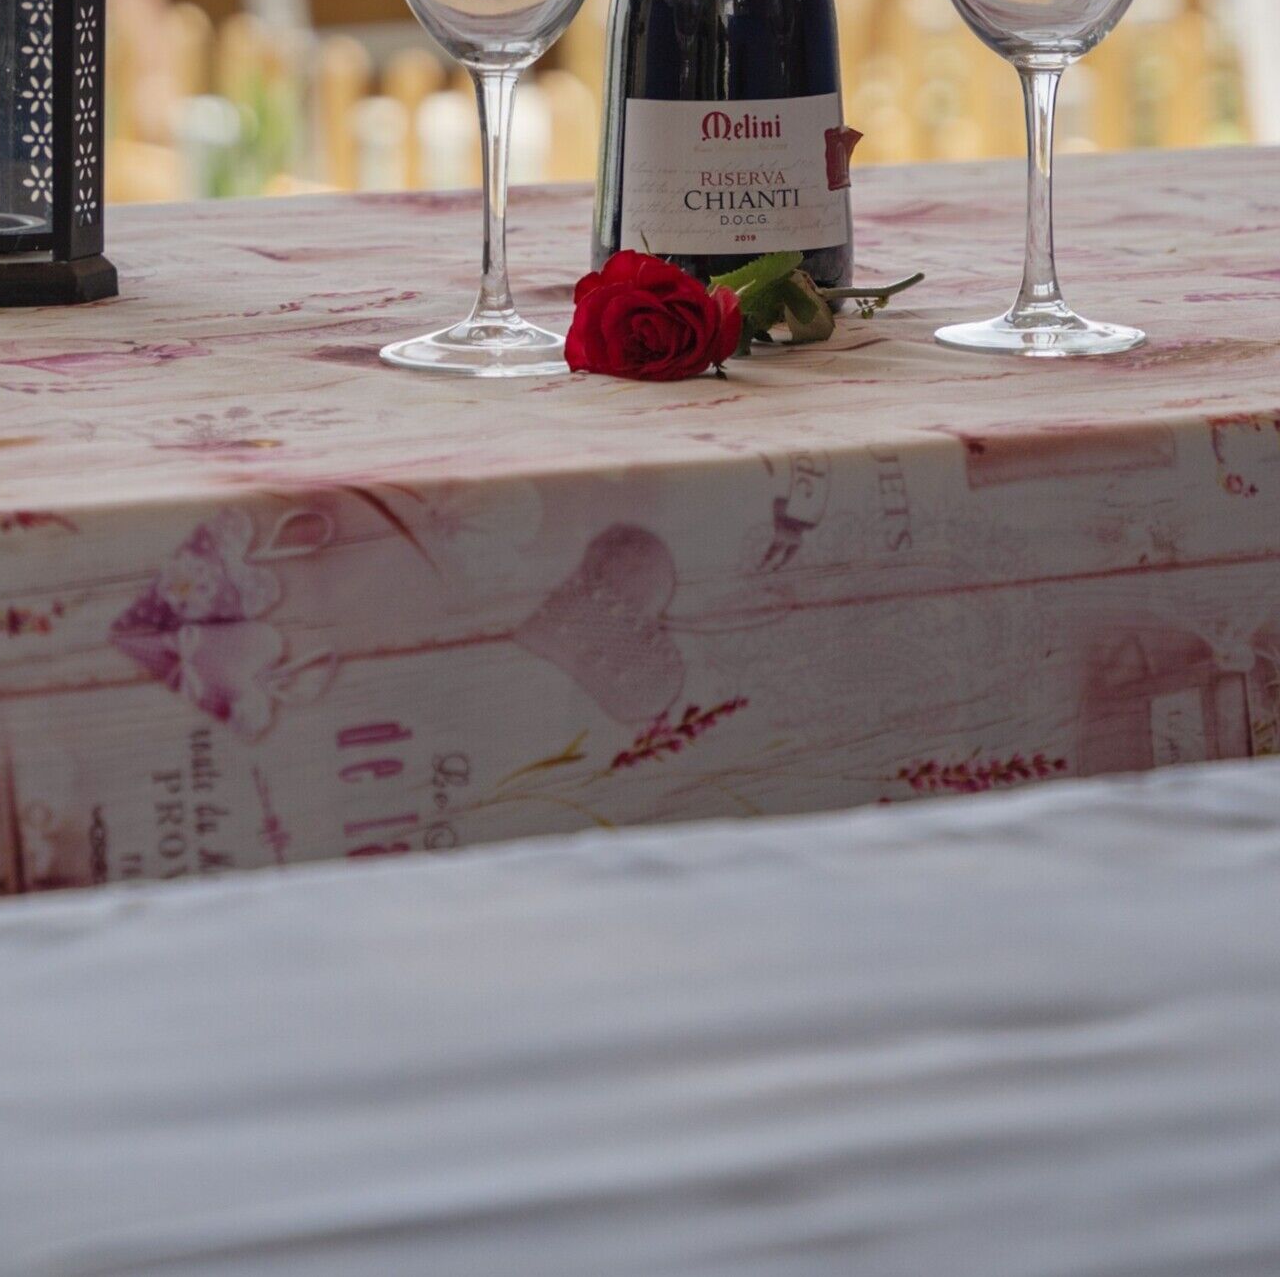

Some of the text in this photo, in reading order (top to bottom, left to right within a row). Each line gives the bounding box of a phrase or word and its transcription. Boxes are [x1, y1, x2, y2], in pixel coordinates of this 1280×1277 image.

[701, 111, 782, 141] Melini
[700, 171, 787, 187] RISERVA
[683, 188, 800, 211] CHIANTI
[734, 233, 757, 243] 2019
